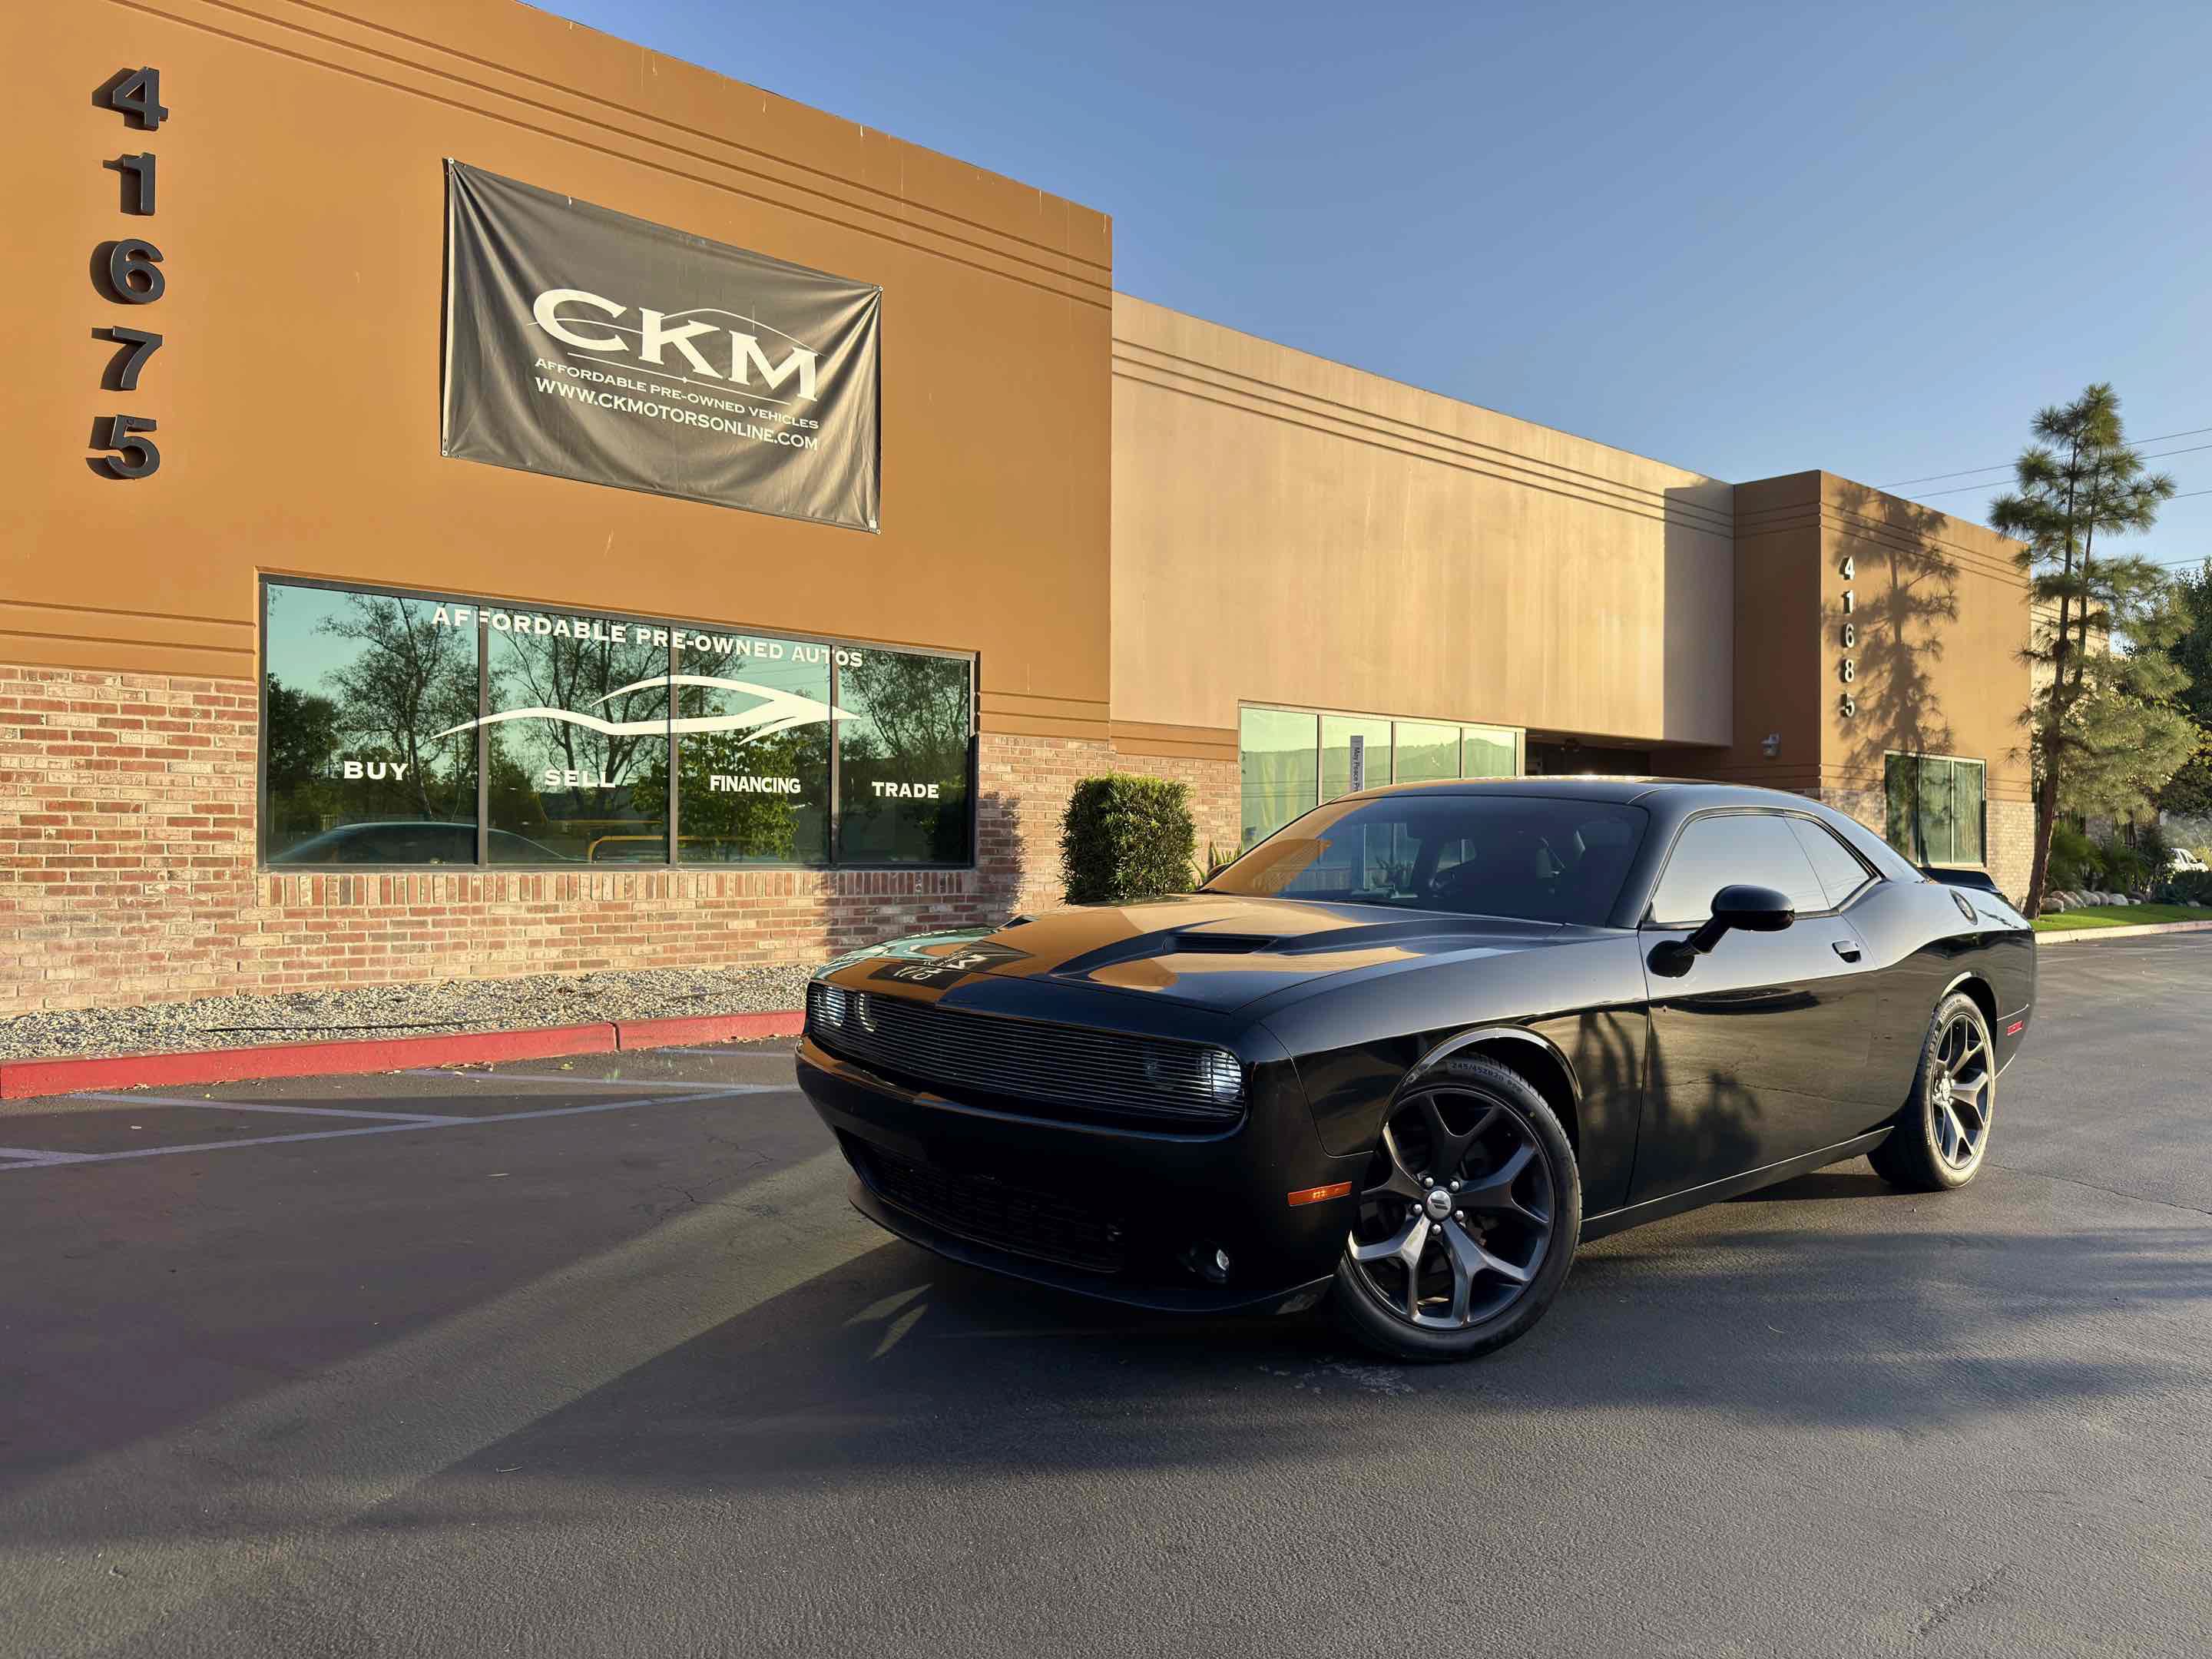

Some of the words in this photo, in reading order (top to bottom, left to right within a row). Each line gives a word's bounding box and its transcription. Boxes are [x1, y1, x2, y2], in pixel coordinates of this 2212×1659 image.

[106, 66, 169, 479] 41675
[533, 288, 818, 401] CKM
[535, 358, 647, 392] AFFORDABLE
[650, 383, 745, 413] PRE-OWNED
[748, 406, 819, 429] VEHICLES
[535, 376, 819, 450] WWW.CKMOTORSONLINE.COM
[430, 607, 627, 643] AFFORDABLE
[636, 628, 783, 660] PRE-OWNED
[791, 646, 863, 667] AUTOS
[1843, 556, 1856, 717] 41685
[343, 760, 409, 781] BUY
[544, 769, 617, 789] SELL
[710, 774, 801, 794] FINANCING
[872, 781, 940, 799] TRADE
